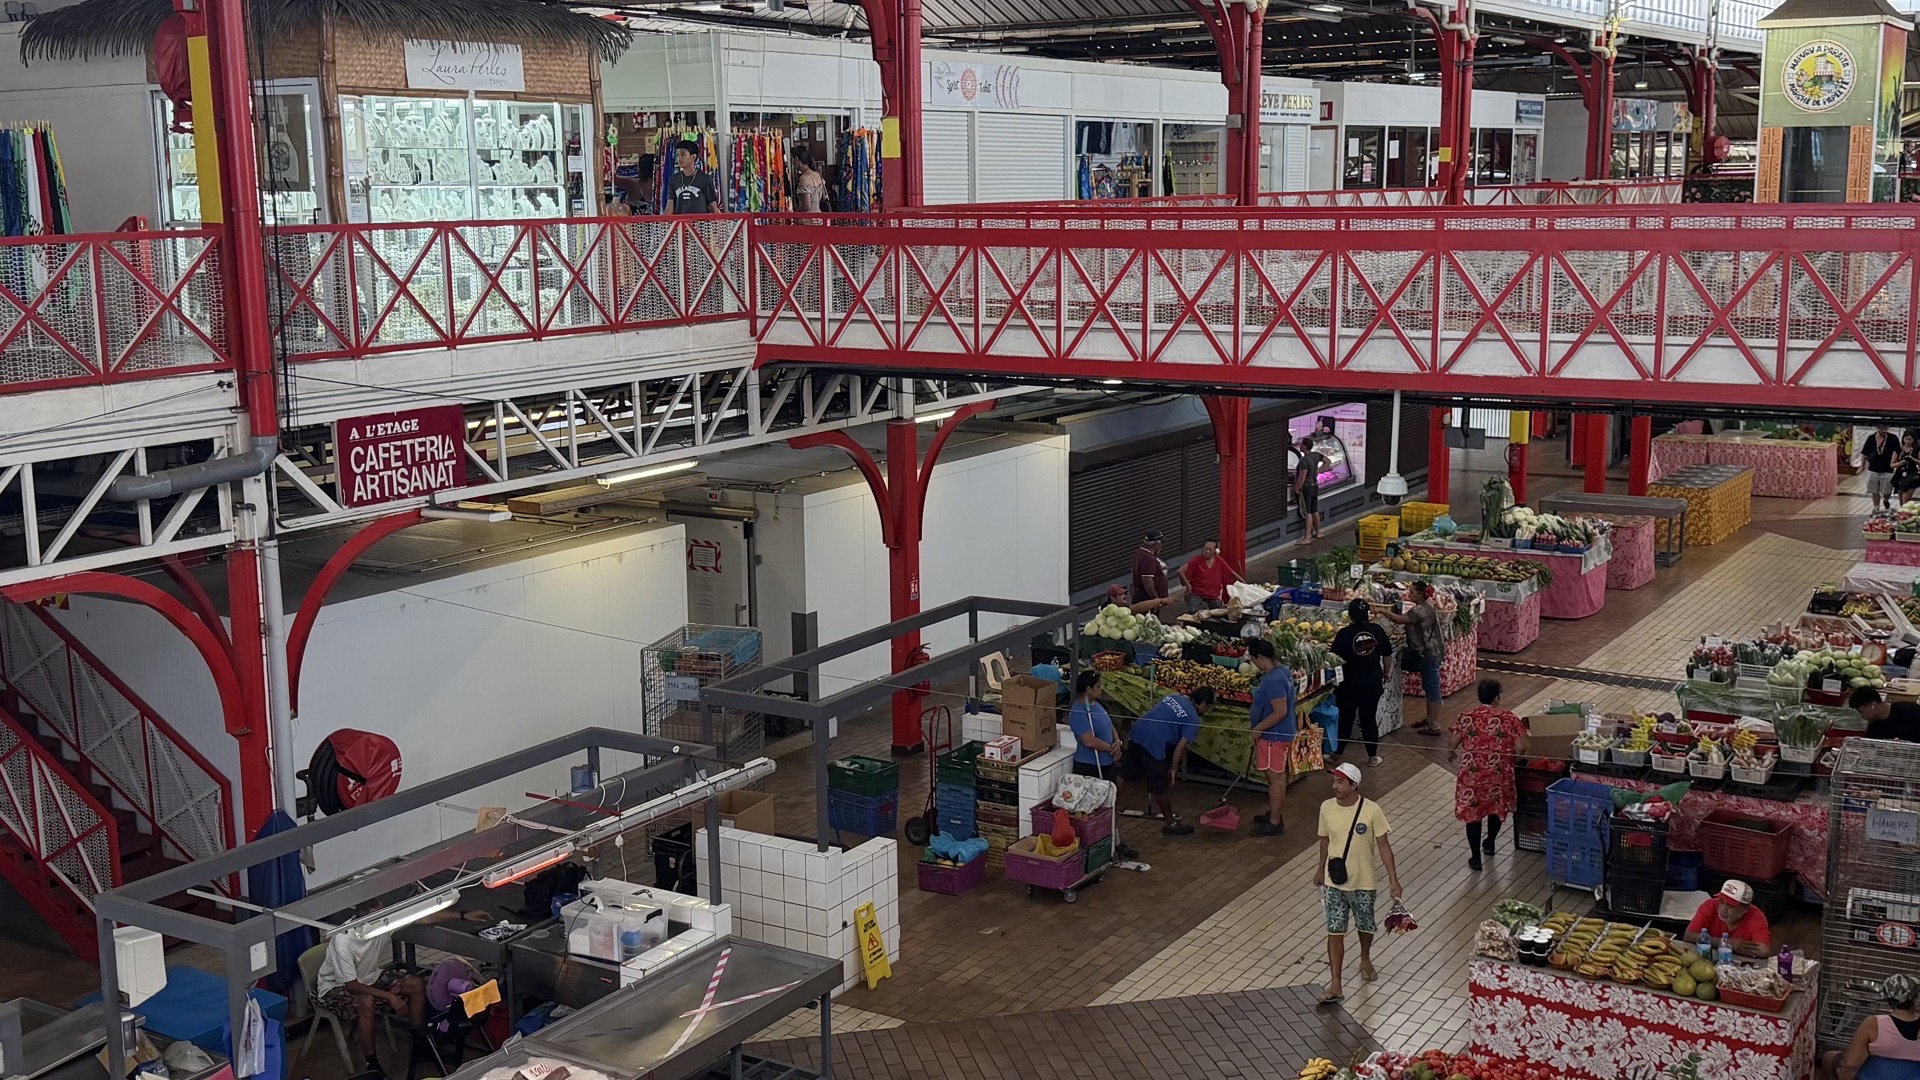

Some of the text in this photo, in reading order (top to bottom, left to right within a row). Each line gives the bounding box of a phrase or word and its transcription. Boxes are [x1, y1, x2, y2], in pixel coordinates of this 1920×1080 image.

[1280, 94, 1313, 110] PERLES
[349, 418, 420, 440] A L'ETAGE
[353, 459, 457, 503] ARTISANAT
